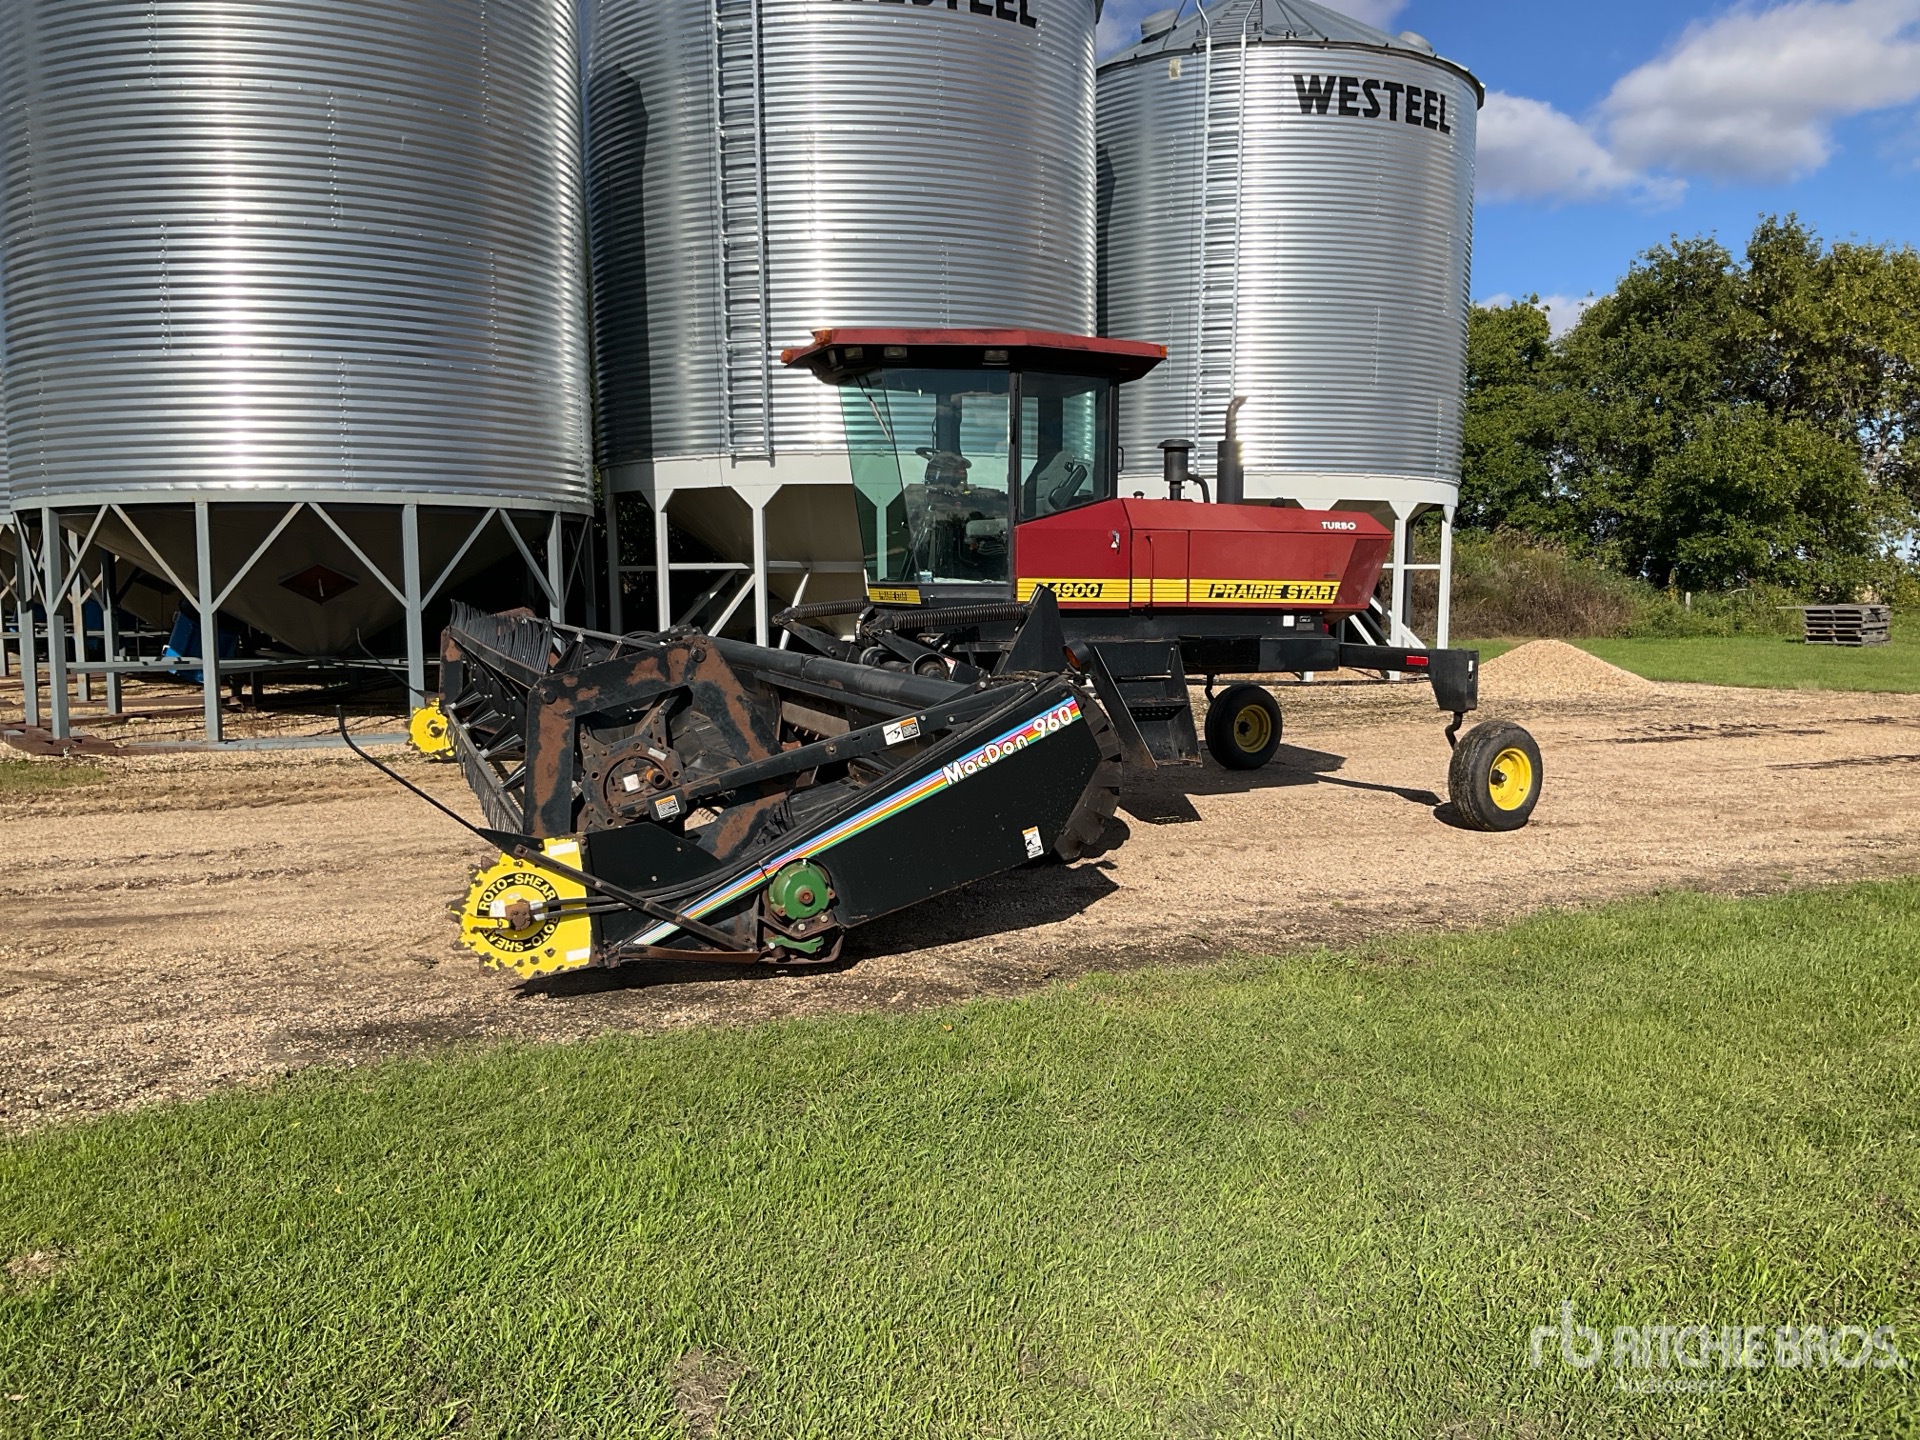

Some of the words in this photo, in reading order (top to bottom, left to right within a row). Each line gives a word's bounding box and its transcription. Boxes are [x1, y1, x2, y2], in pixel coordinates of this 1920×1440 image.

[1293, 75, 1450, 134] WESTEEL
[1321, 521, 1356, 531] TURBO
[1050, 583, 1100, 598] 4900
[1210, 584, 1285, 599] PRAIRIE
[1286, 585, 1331, 600] STAR
[942, 734, 1029, 786] MacDon
[1032, 706, 1073, 738] 960
[479, 873, 556, 911] ROTO-SHEAR
